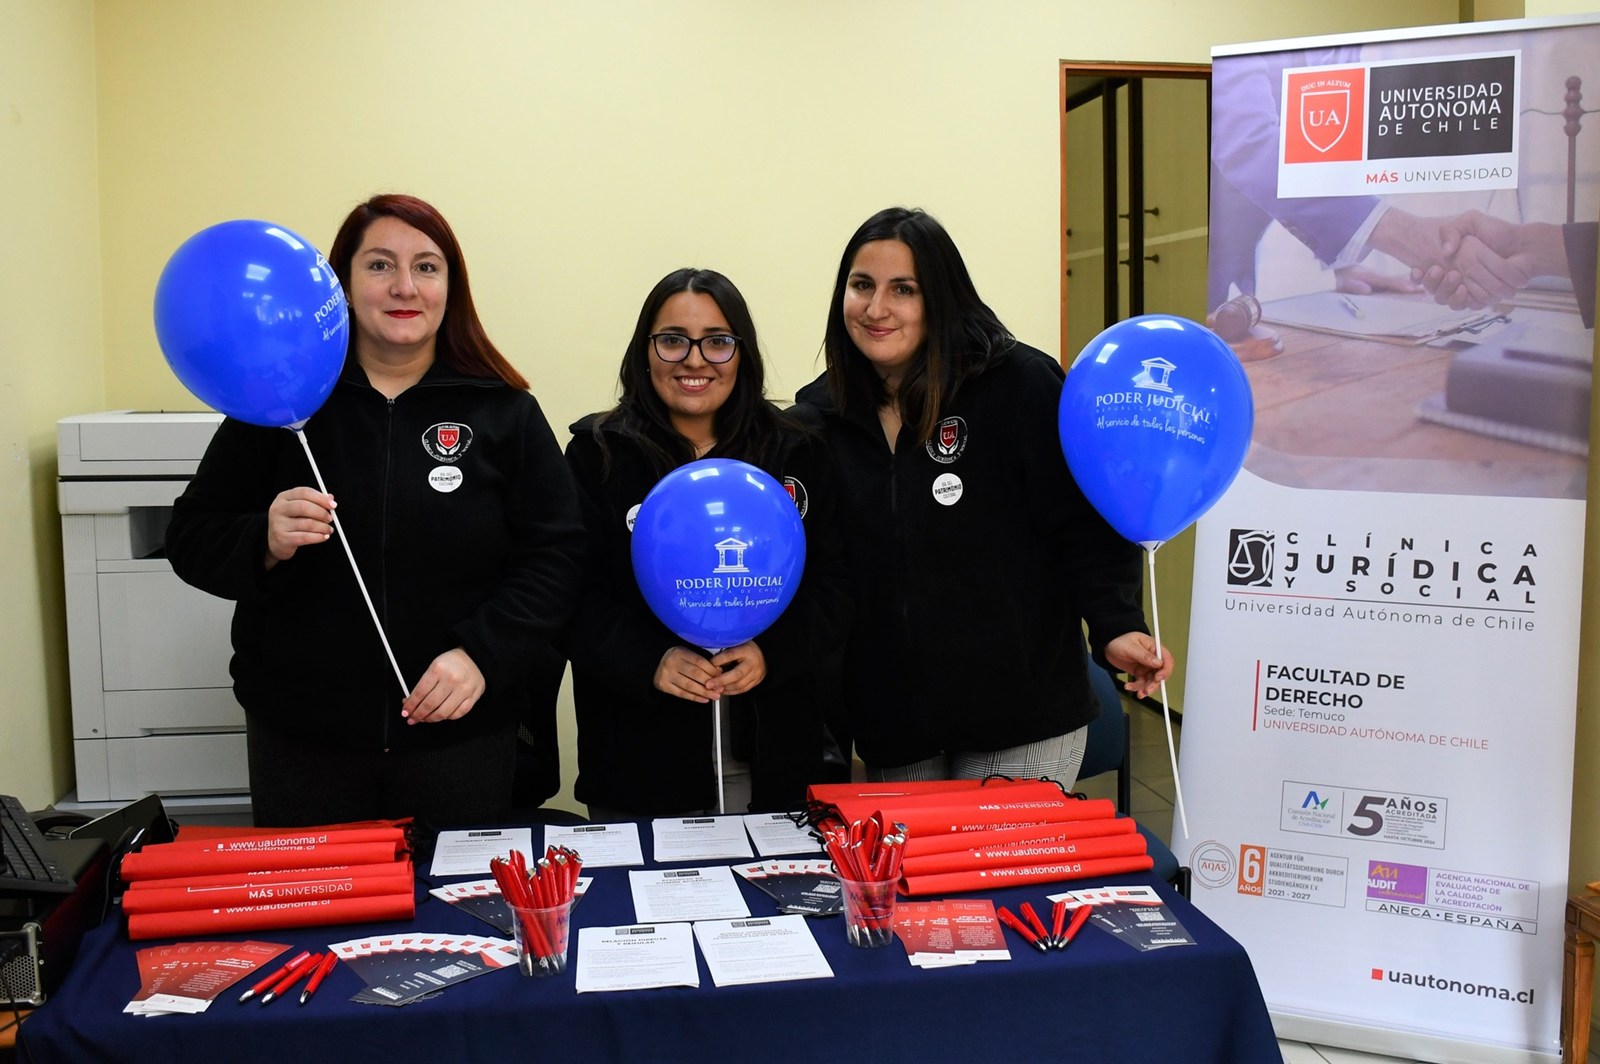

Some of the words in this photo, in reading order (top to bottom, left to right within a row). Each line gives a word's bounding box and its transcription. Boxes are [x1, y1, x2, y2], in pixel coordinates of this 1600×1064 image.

[1301, 83, 1316, 92] DUC
[1326, 80, 1351, 88] ALTUM
[1380, 82, 1502, 104] UNIVERSIDAD
[1379, 98, 1502, 121] AUTONOMA
[1308, 109, 1341, 127] UA
[1378, 124, 1403, 136] DE
[1422, 118, 1498, 134] CHILE
[1366, 171, 1398, 184] MÁS
[1404, 166, 1512, 182] UNIVERSIDAD
[1096, 392, 1143, 406] PODER
[1146, 394, 1210, 424] JUDICIAL
[943, 431, 955, 440] UA
[1105, 419, 1129, 428] servicio
[1131, 415, 1140, 426] de
[1165, 419, 1175, 434] las
[1176, 429, 1205, 444] personas
[935, 484, 961, 495] PATRIMONIO
[1286, 532, 1537, 557] CLÍNICA
[1284, 552, 1536, 586] JURÍDICA
[676, 578, 723, 589] PODER
[727, 576, 783, 590] JUDICIAL
[1284, 577, 1295, 588] Y
[1346, 580, 1535, 604] SOCIAL
[713, 597, 722, 607] de
[1225, 599, 1335, 618] Universidad
[1343, 606, 1443, 625] Autónoma
[1452, 614, 1475, 627] de
[1484, 616, 1535, 631] Chile
[1267, 665, 1370, 686] FACULTAD
[1377, 674, 1405, 690] DE
[1266, 687, 1363, 709] DERECHO
[1264, 705, 1295, 718] Sede:
[1298, 709, 1345, 722] Temuco
[1263, 720, 1347, 736] UNIVERSIDAD
[1350, 727, 1425, 744] AUTÓNOMA
[1429, 735, 1446, 746] DE
[1450, 737, 1488, 750] CHILE
[1386, 797, 1437, 813] AÑOS
[1347, 796, 1387, 837] 5
[1385, 809, 1437, 820] ACREDITADA
[230, 835, 326, 849] www.uautonoma.cl
[986, 845, 1076, 858] www.uautonoma.cl
[992, 864, 1081, 877] www.uautonoma.cl
[1201, 861, 1226, 872] AQAS
[1243, 848, 1261, 884] 6
[1238, 884, 1262, 893] AÑOS
[1436, 873, 1472, 883] AGENCIA
[1474, 877, 1516, 889] NACIONAL
[1436, 881, 1488, 893] EVALUACIÓN
[249, 888, 274, 899] MÁS
[277, 883, 353, 896] UNIVERSIDAD
[1292, 892, 1311, 900] 2027
[1447, 890, 1483, 901] CALIDAD
[226, 899, 330, 914] www.uautonoma.cl
[1441, 897, 1502, 912] ACREDITACIÓN
[1378, 903, 1431, 918] ANECA
[1444, 912, 1524, 931] ESPAÑA
[1388, 970, 1534, 1004] uautonoma.cl
